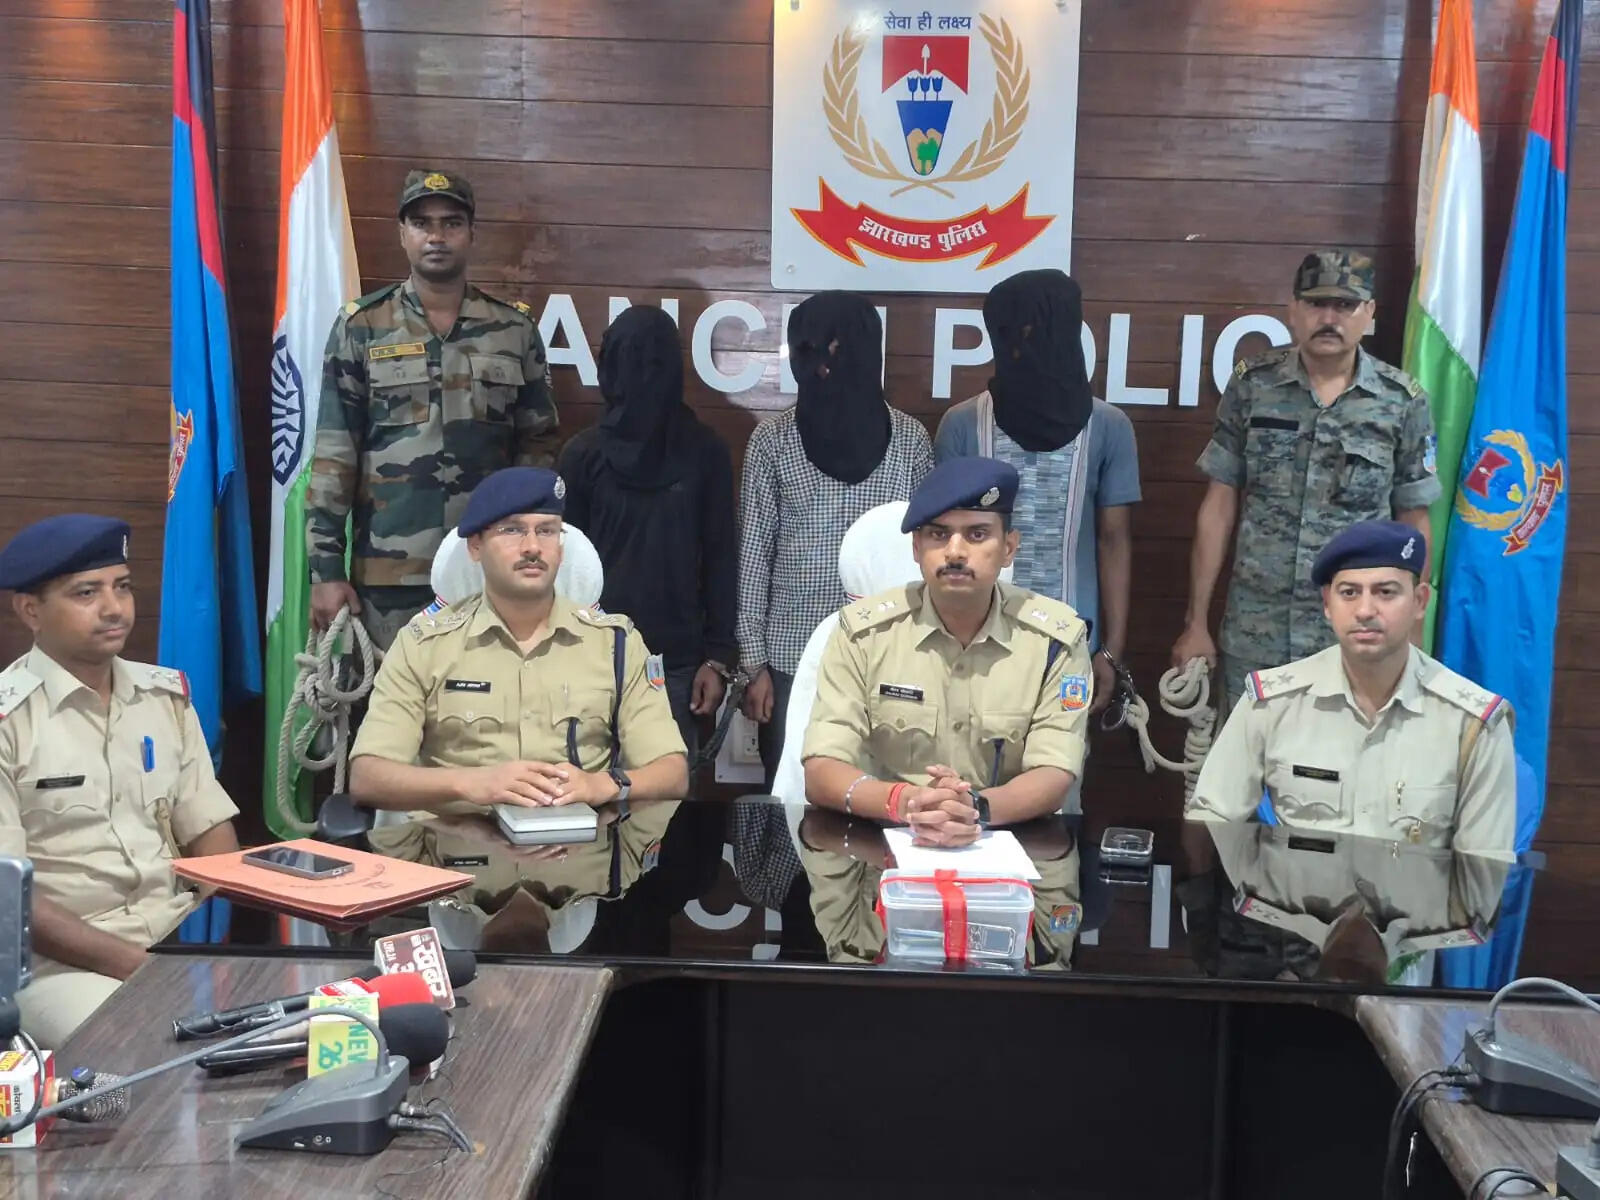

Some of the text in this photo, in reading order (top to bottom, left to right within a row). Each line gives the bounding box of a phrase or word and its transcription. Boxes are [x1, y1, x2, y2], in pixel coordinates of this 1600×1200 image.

[883, 11, 972, 31] सेवा ही लक्ष्य
[858, 216, 987, 252] झारखण्ड पुलिस
[931, 308, 1374, 406] PLIC
